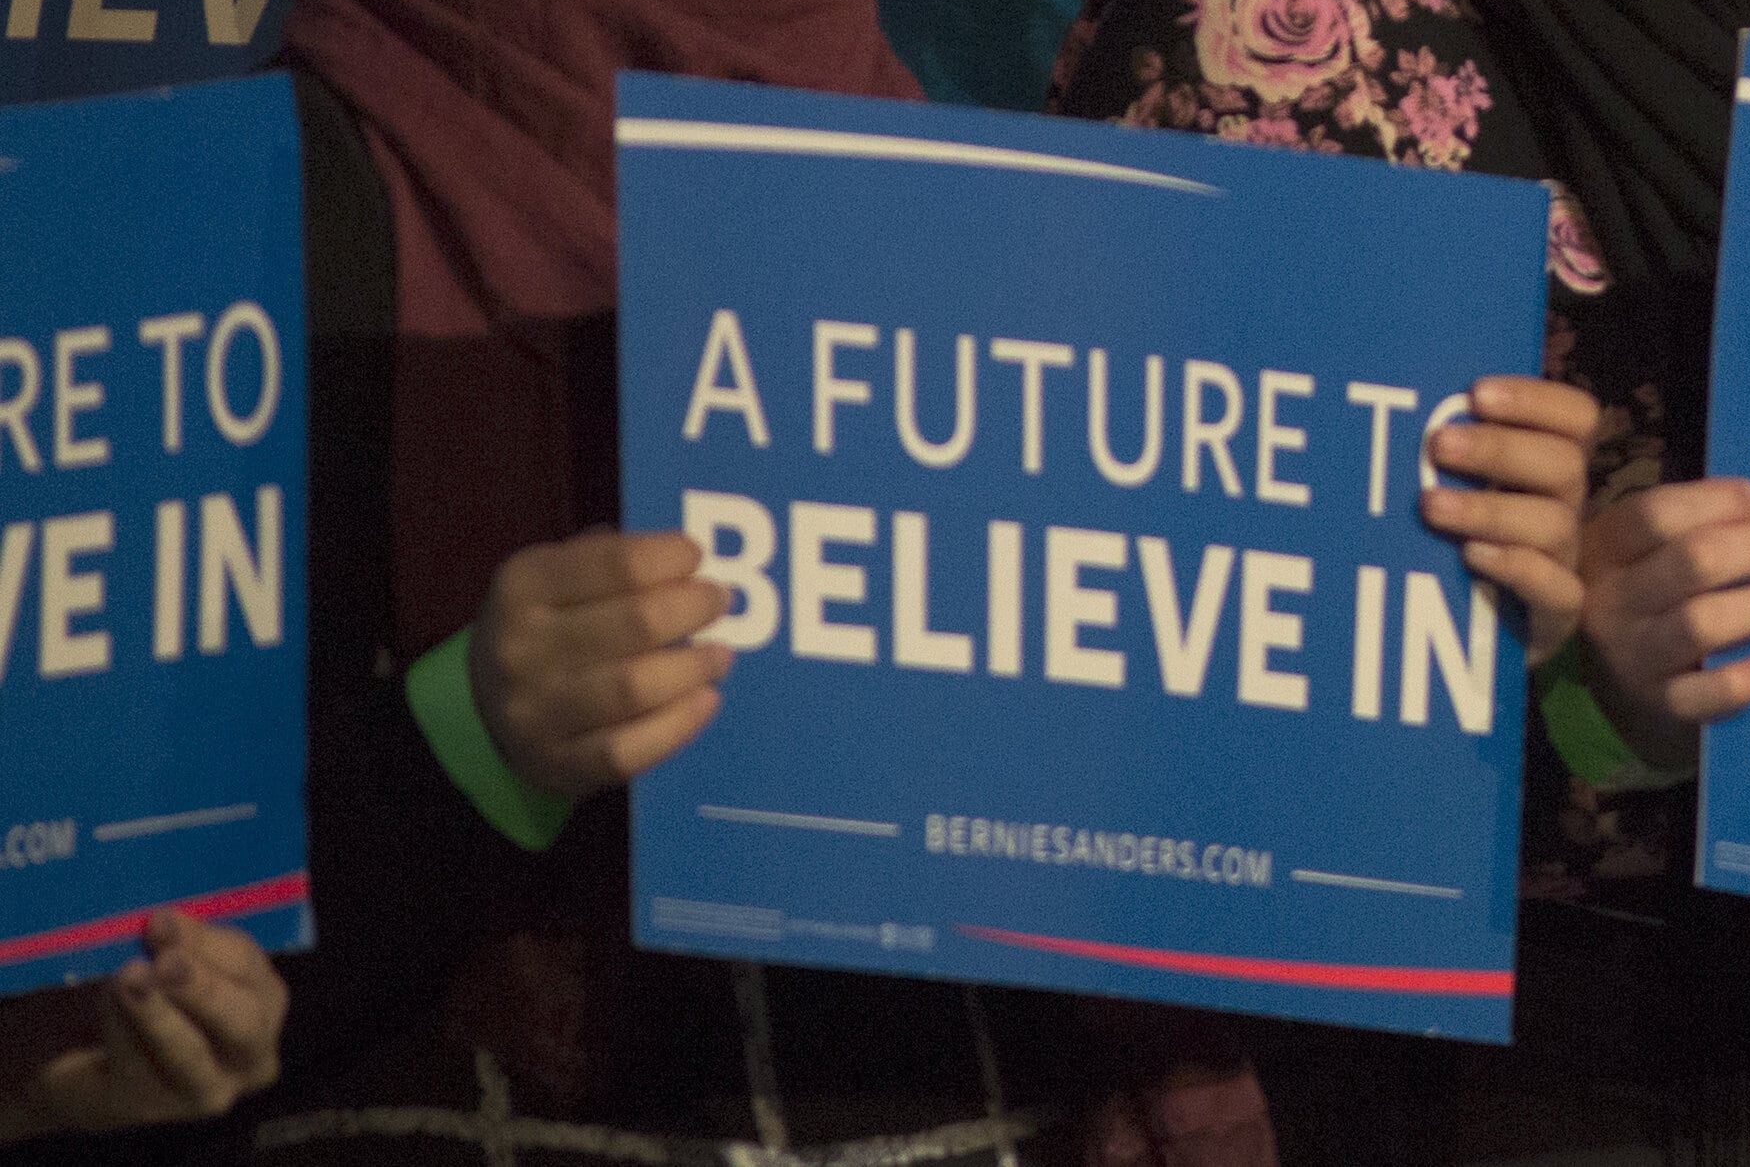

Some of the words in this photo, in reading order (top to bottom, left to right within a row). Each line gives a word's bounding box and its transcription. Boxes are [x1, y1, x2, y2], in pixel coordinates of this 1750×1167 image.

[139, 301, 281, 453] TO
[682, 309, 772, 449] A
[811, 318, 1317, 507] FUTURE
[153, 485, 283, 661] IN
[681, 488, 1316, 712] BELIEVE
[1350, 563, 1498, 736] IN
[925, 813, 1273, 887] BERNIESANDERS.COM
